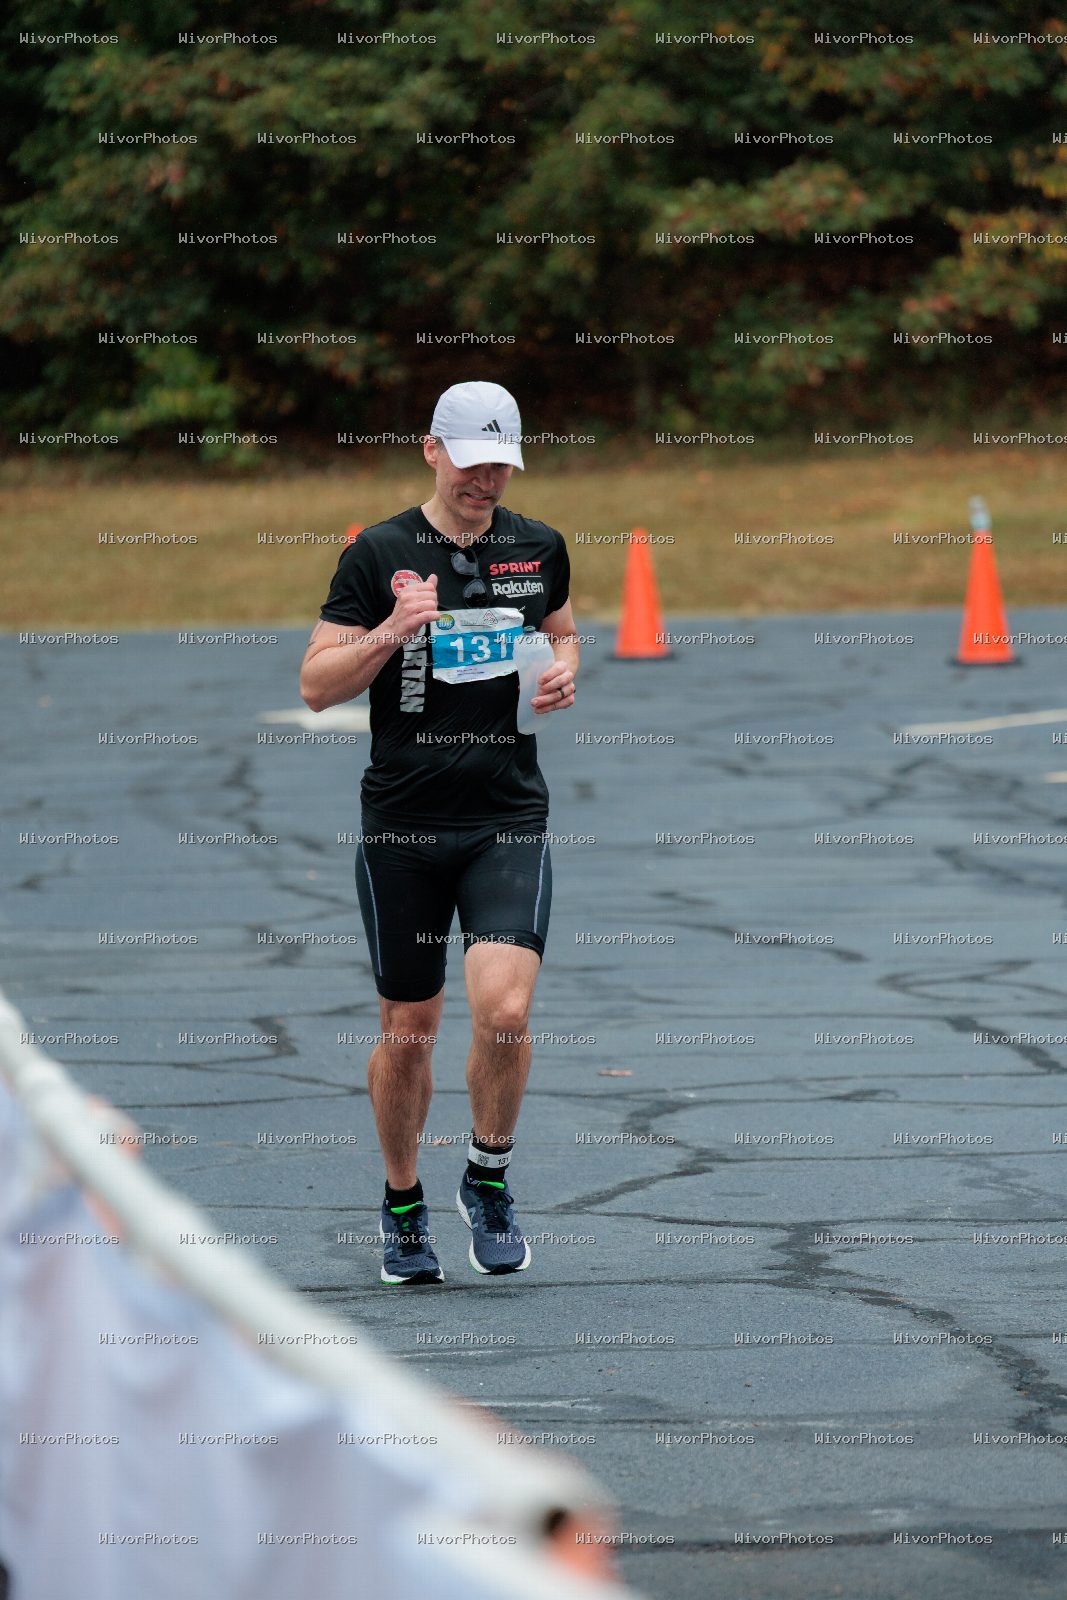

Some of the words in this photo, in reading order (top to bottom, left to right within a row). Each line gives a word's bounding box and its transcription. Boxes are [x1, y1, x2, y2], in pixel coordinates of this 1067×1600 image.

[489, 561, 542, 576] SPRINT
[491, 580, 544, 597] Rakuten
[449, 633, 507, 663] 131
[399, 623, 427, 713] ARTAN
